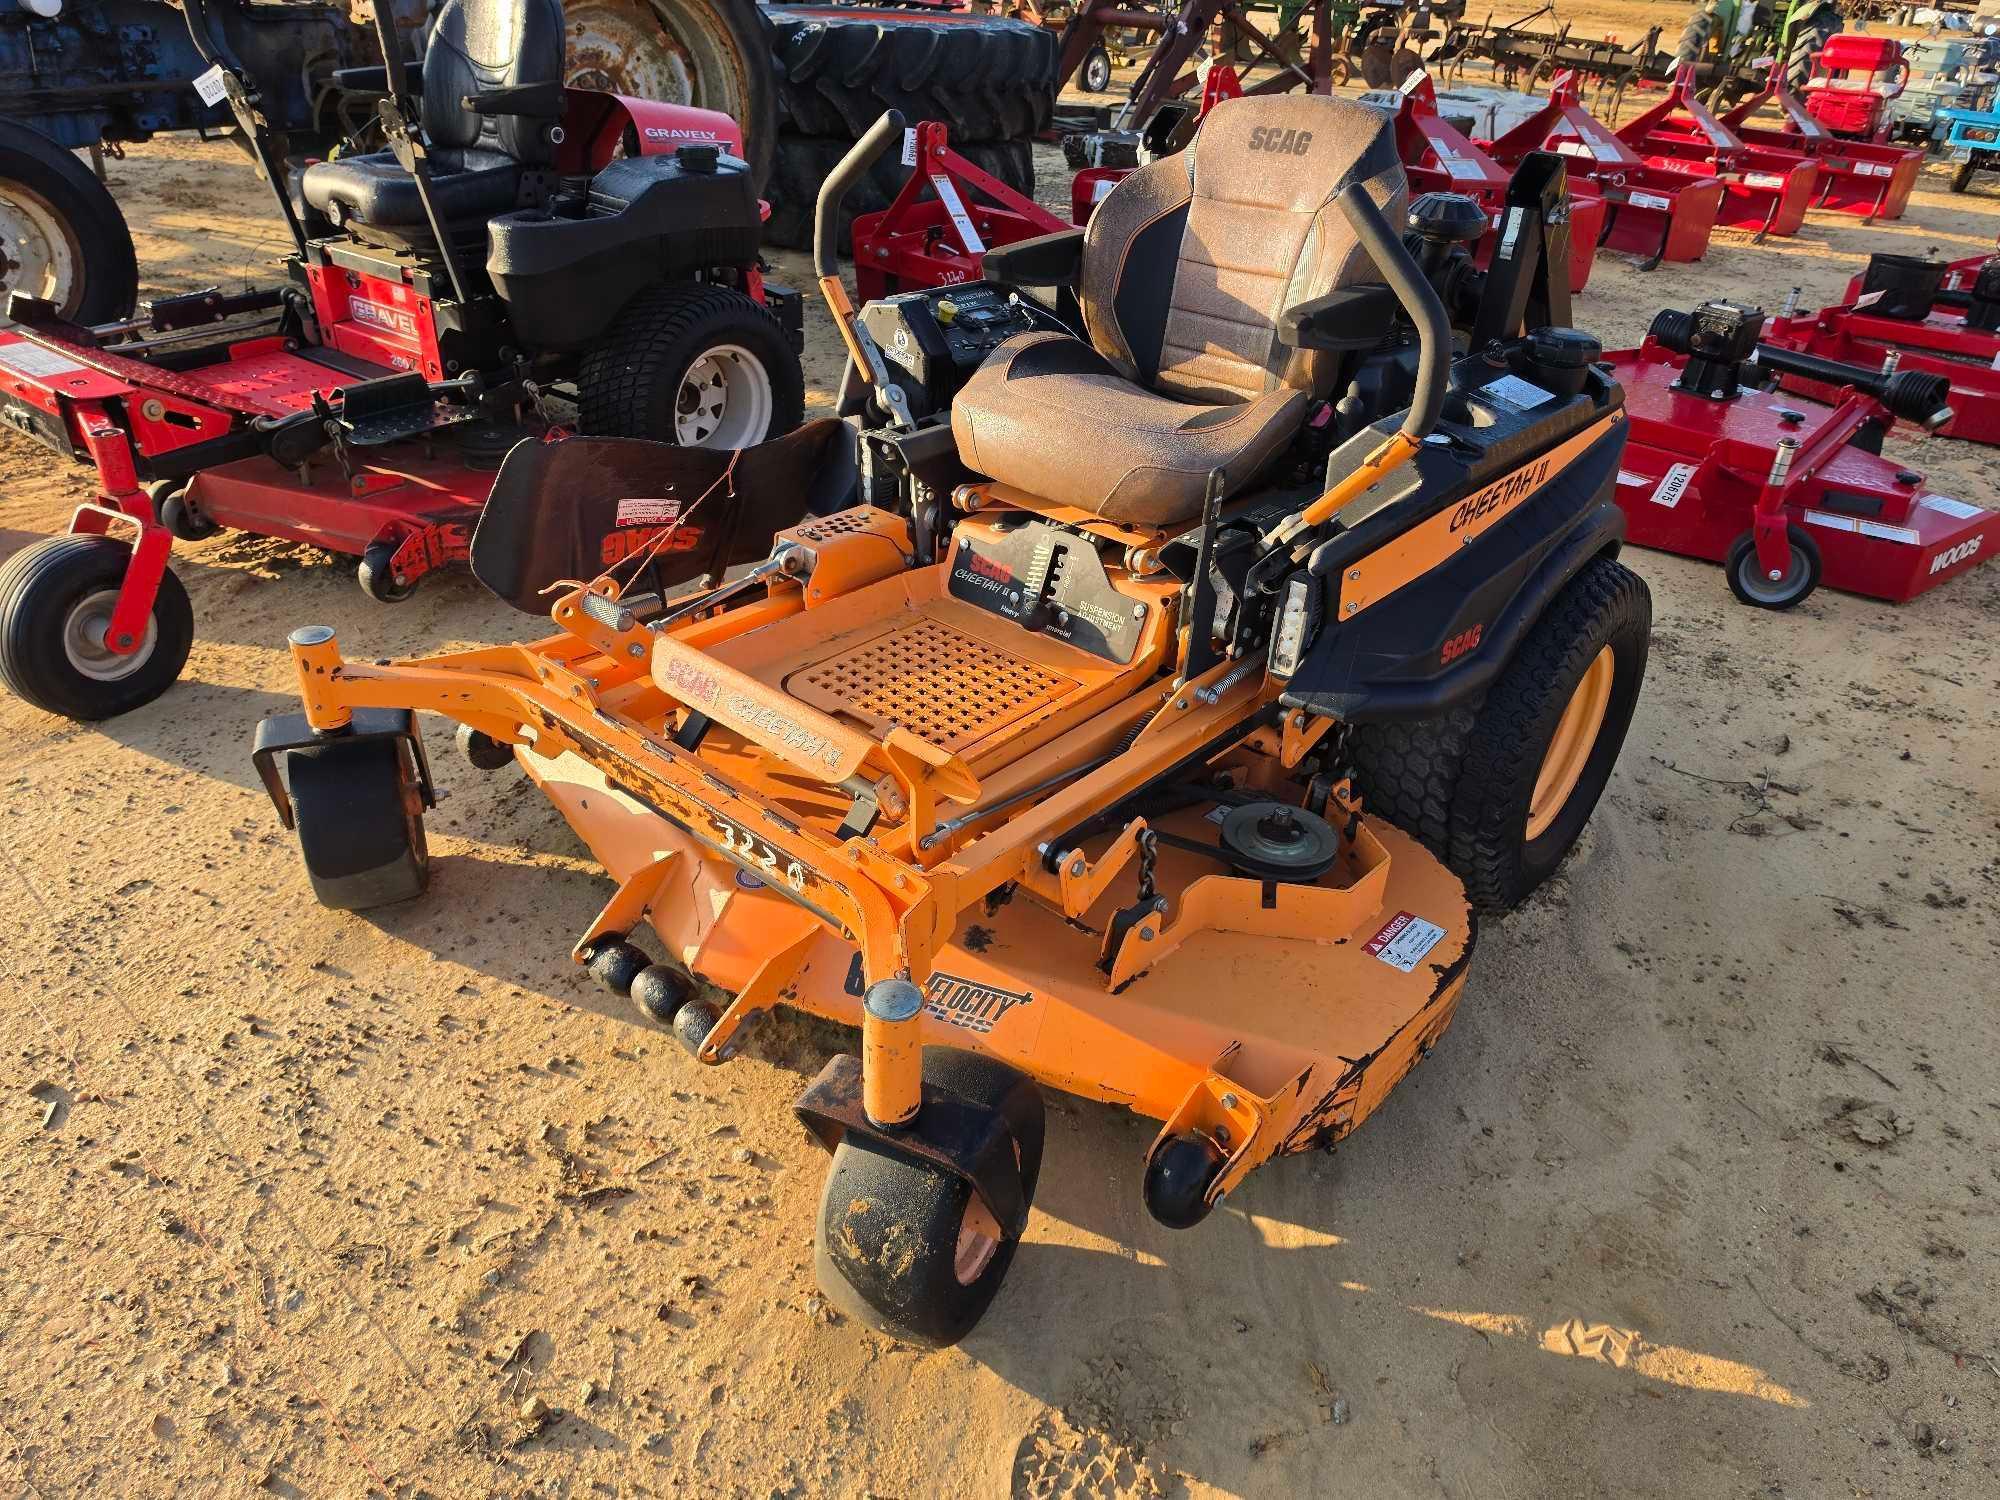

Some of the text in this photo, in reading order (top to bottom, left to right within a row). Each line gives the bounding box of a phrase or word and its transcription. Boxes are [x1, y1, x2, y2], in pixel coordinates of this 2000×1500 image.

[645, 127, 716, 140] GRAVELY
[1249, 125, 1314, 156] SCAG
[352, 299, 420, 336] GRAVEL
[1449, 459, 1551, 533] CHEETAH II
[1661, 472, 1688, 502] 120675
[601, 526, 705, 566] SCAG
[1929, 534, 1984, 575] WOODS
[954, 567, 1003, 596] CHEETAH
[969, 553, 1015, 584] SCAG
[1000, 604, 1020, 618] Heavy
[1077, 610, 1123, 633] ADJUSTMENT
[1079, 600, 1126, 625] SUSPENSION
[1440, 624, 1482, 665] SCAG
[665, 657, 719, 702] SCAG
[727, 696, 828, 760] CHEETAH
[716, 820, 806, 895] 3220
[1377, 915, 1410, 943] DANGER
